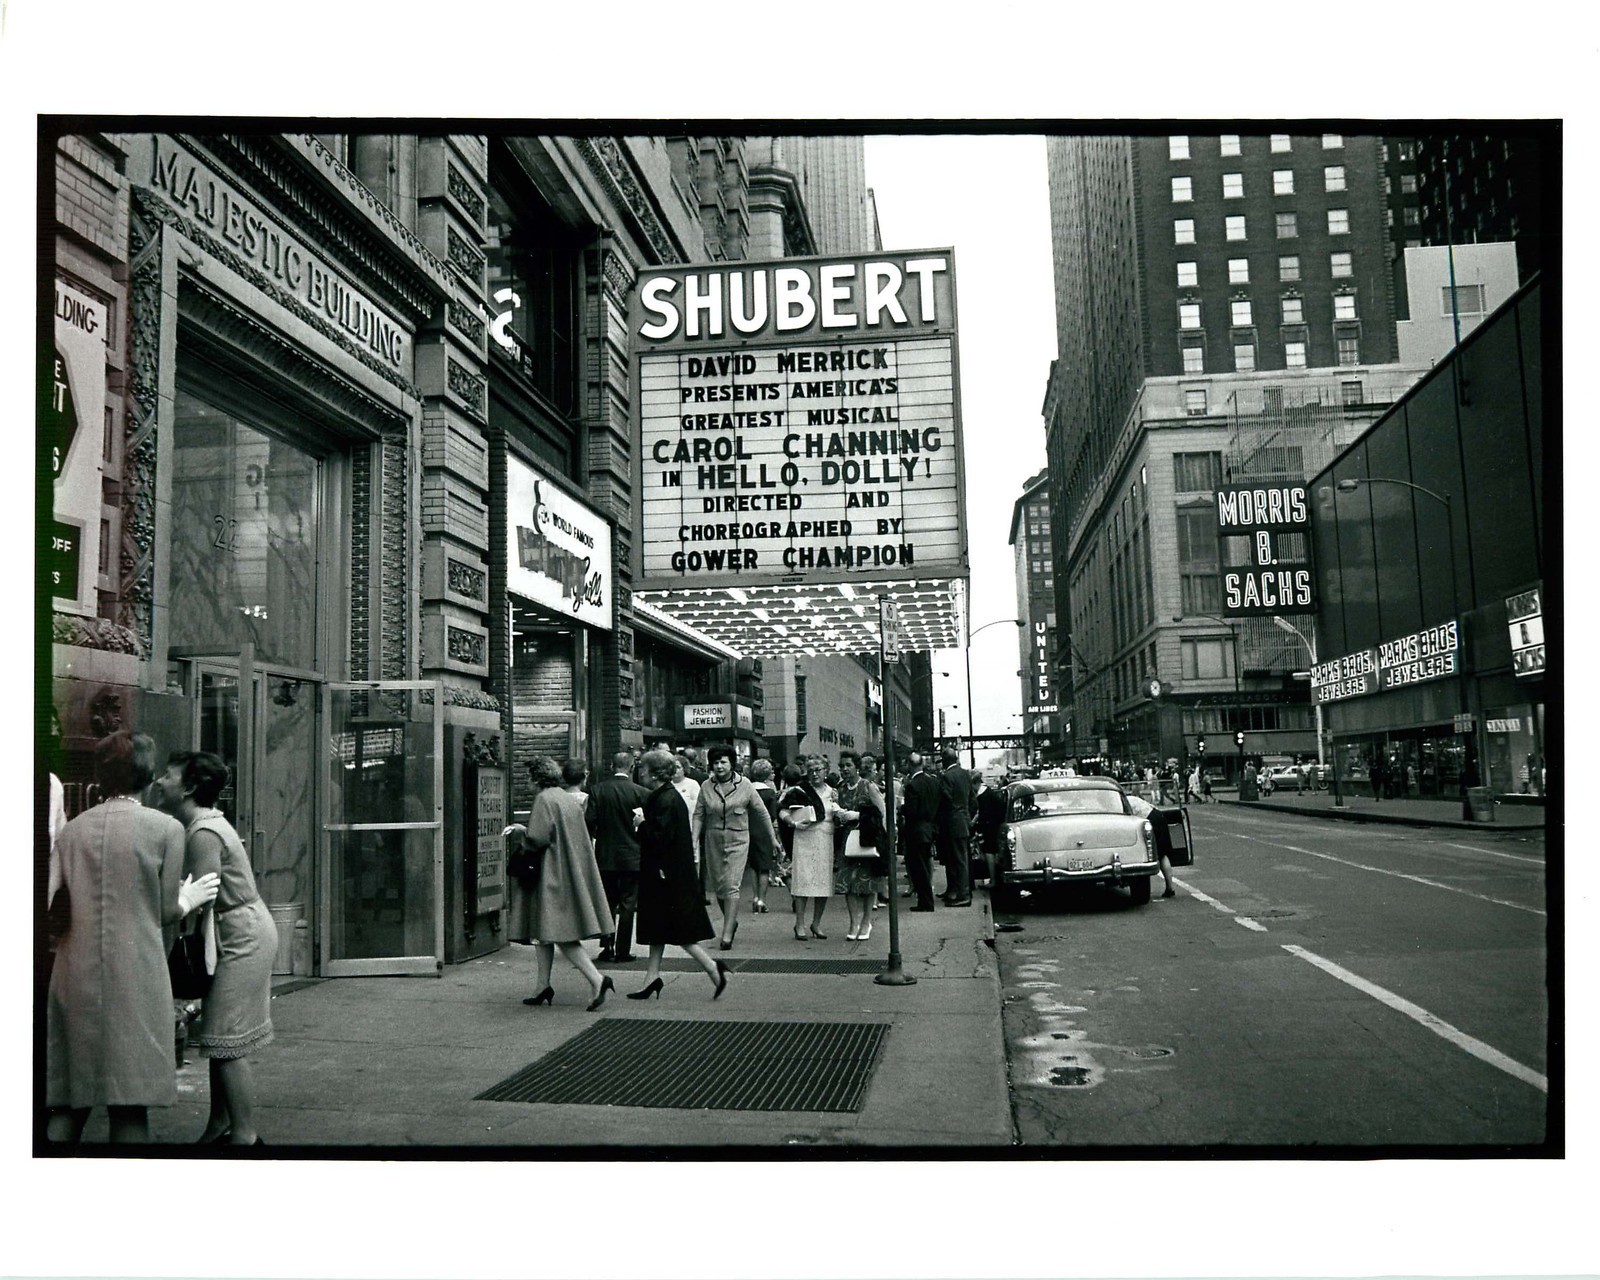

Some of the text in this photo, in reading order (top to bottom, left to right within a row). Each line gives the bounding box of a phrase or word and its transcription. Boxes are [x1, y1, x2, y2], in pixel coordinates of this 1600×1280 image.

[151, 134, 302, 290] MAJESTIC
[307, 260, 402, 367] BUILDING
[639, 258, 947, 339] SHUBERT
[688, 348, 888, 378] DAVID MERRICK
[681, 377, 898, 403] PRESENTS AMERICA'S
[681, 406, 899, 431] GREATEST MUSICAL
[653, 427, 941, 464] CAROL CHANNING
[662, 457, 932, 490] IN HELLO, DOLLY!
[703, 491, 890, 513] DIRECTED AND
[1218, 488, 1306, 526] MORRIS
[552, 512, 594, 549] WORLD FAMOUS
[678, 518, 902, 541] CHOREOGRAPHED BY
[671, 543, 914, 572] GOWER CHAMPION
[1256, 531, 1278, 565] B.
[1225, 570, 1311, 608] SACHS
[1035, 622, 1049, 700] UNITED
[1379, 620, 1458, 669] MARKS BROS
[1311, 659, 1340, 688] MARKS
[1386, 653, 1454, 687] JEWELERS
[1318, 676, 1367, 702] JEWELERS
[690, 716, 726, 725] JEWELRY
[692, 707, 723, 716] FASHION
